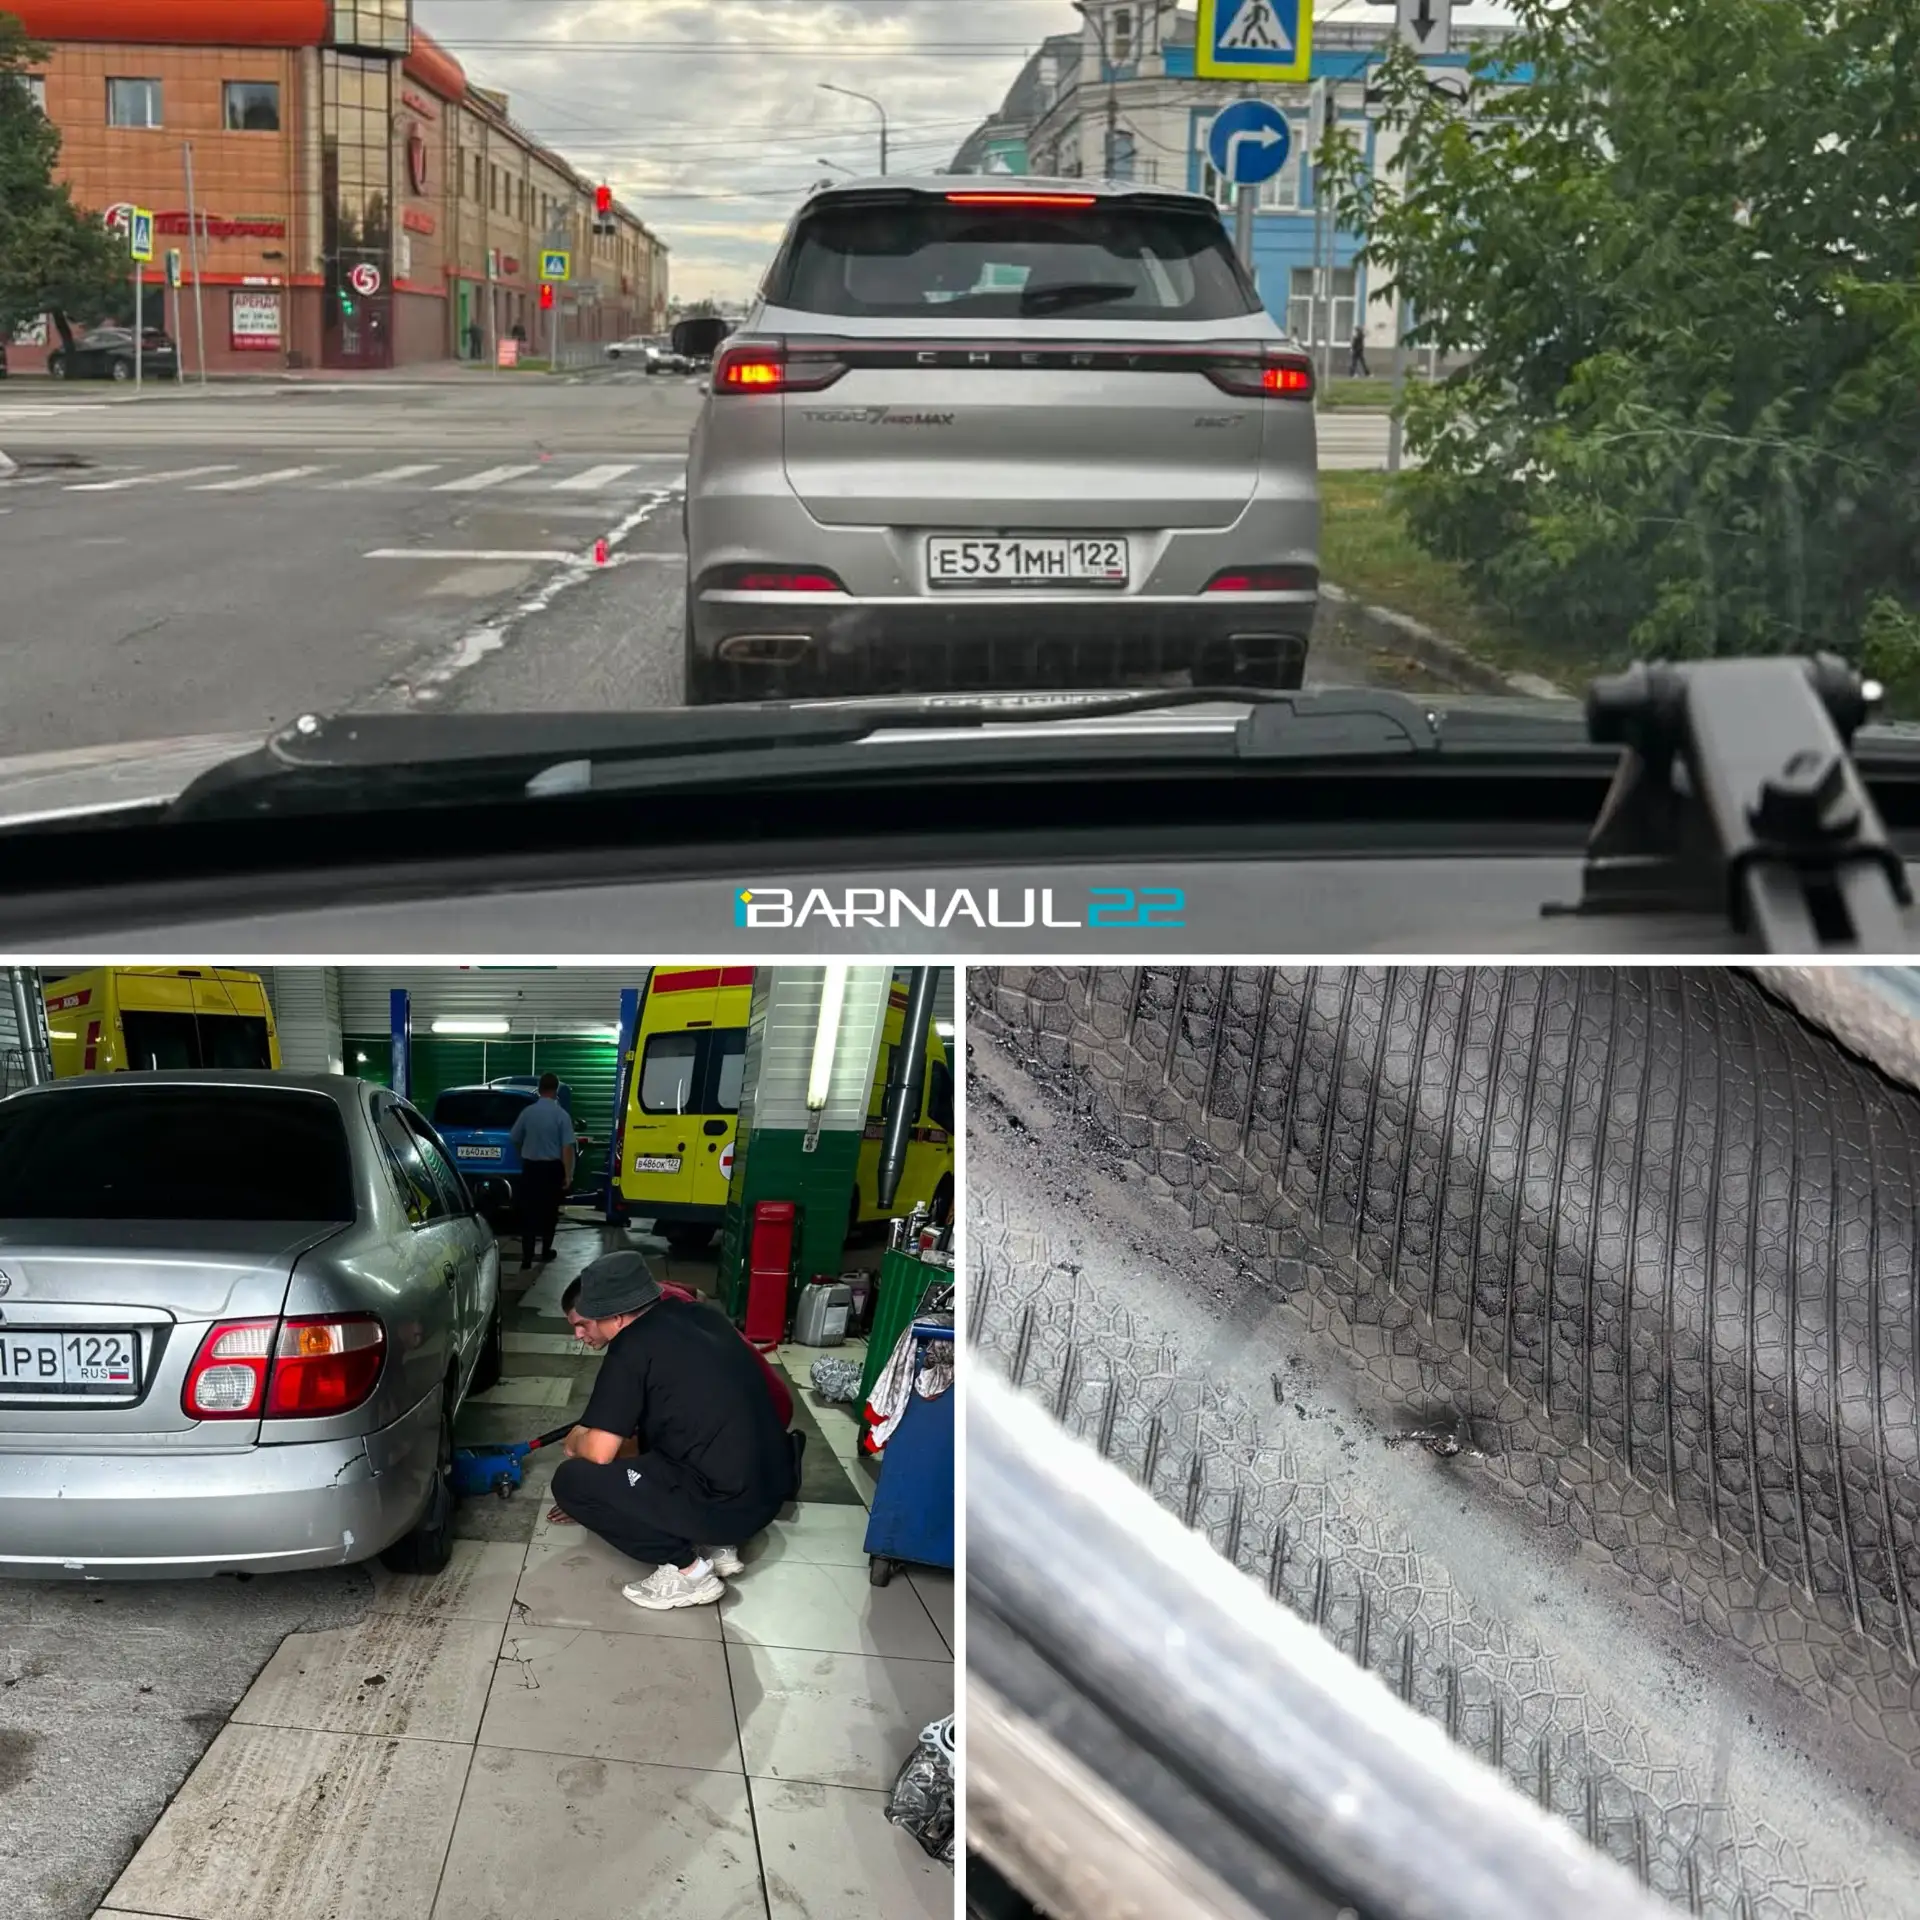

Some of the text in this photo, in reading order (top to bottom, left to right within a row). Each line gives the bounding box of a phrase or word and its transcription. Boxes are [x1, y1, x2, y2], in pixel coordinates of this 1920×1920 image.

[235, 294, 280, 309] АРЕНДА
[916, 351, 1140, 368] CHERY
[940, 543, 1119, 574] Е531МН 122
[667, 1159, 679, 1167] 122
[67, 1337, 122, 1367] 122
[81, 1367, 108, 1379] RUS
